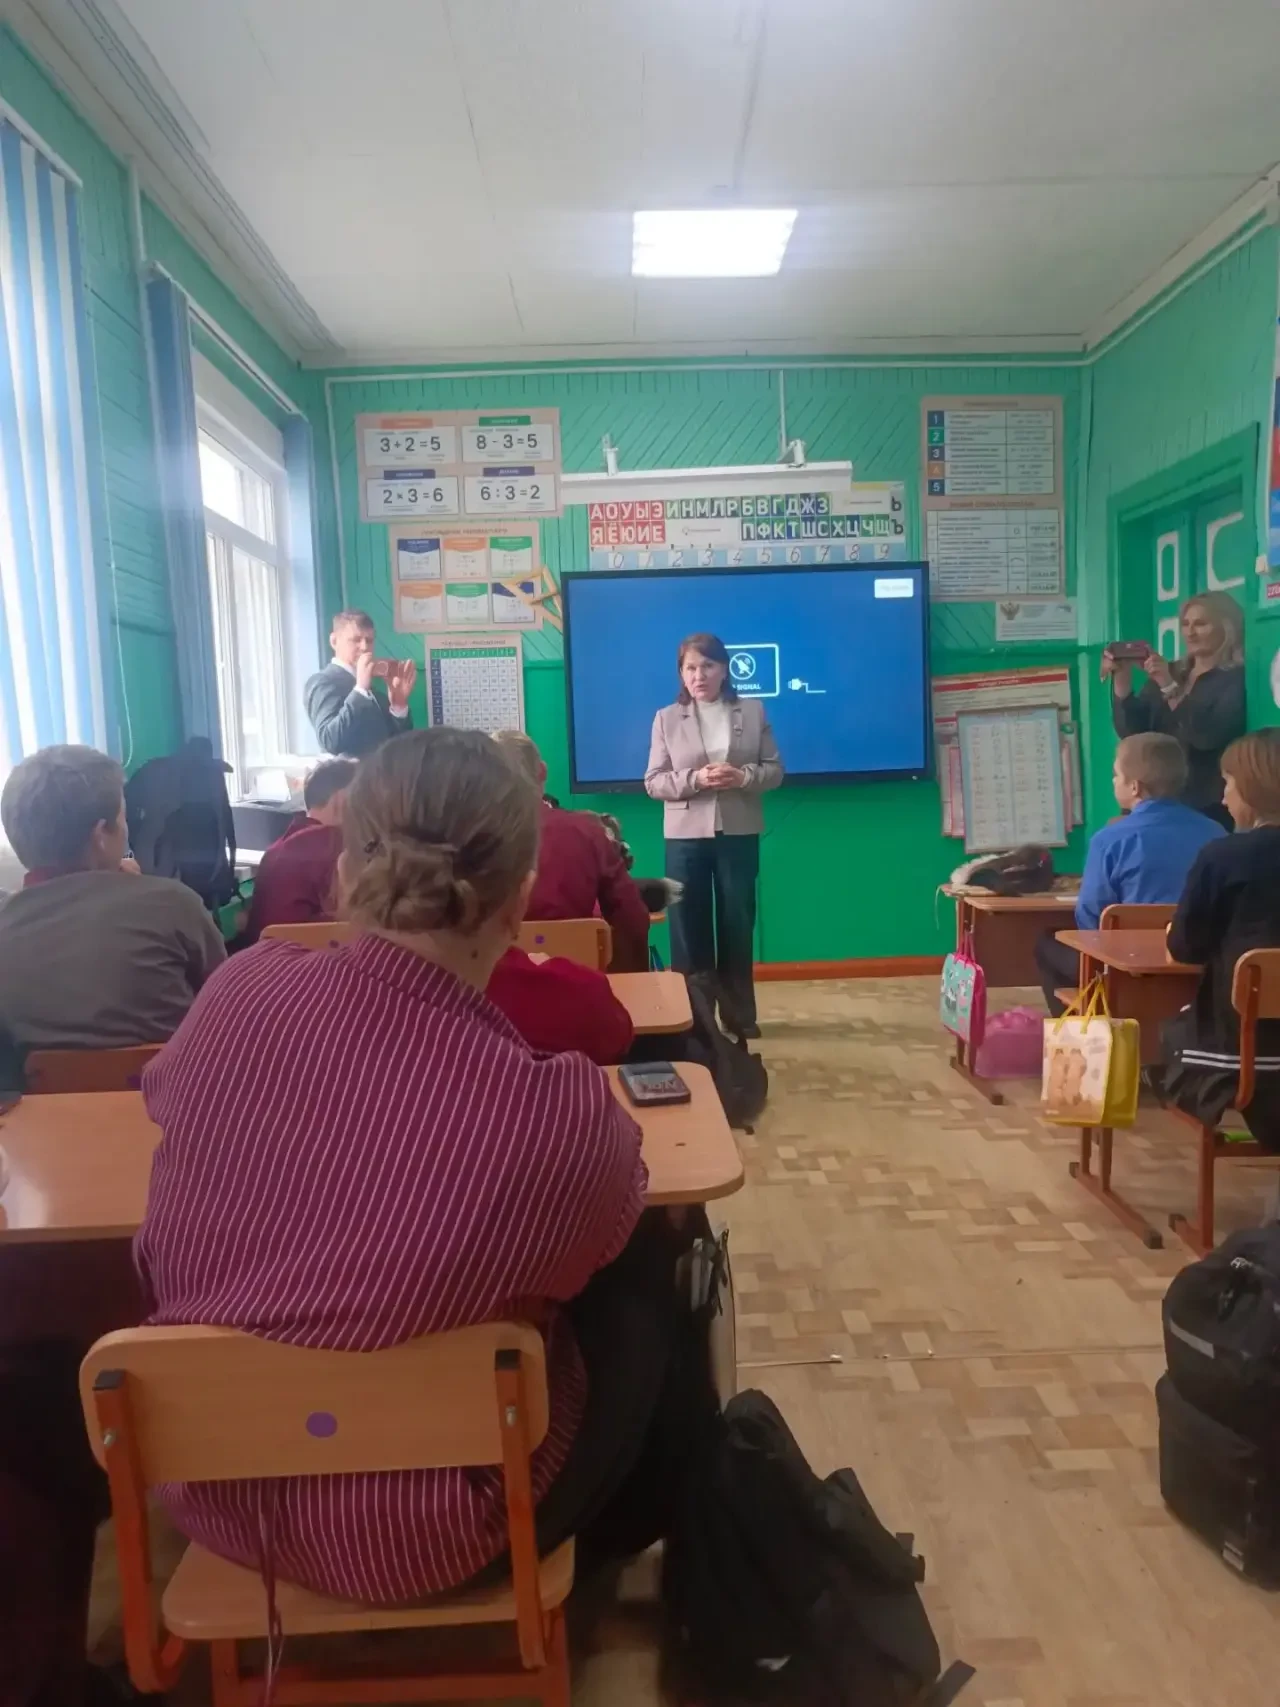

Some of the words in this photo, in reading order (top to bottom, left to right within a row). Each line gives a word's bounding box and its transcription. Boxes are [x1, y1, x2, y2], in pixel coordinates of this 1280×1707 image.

[932, 431, 940, 442] 2
[932, 448, 940, 458] 3
[932, 482, 940, 492] 5
[671, 550, 684, 567] 2
[702, 549, 714, 566] 3
[732, 549, 743, 565] 4
[760, 547, 771, 564] 5
[790, 546, 801, 563] 6
[820, 545, 831, 562] 7
[849, 543, 860, 561] 8
[879, 543, 890, 560] 9
